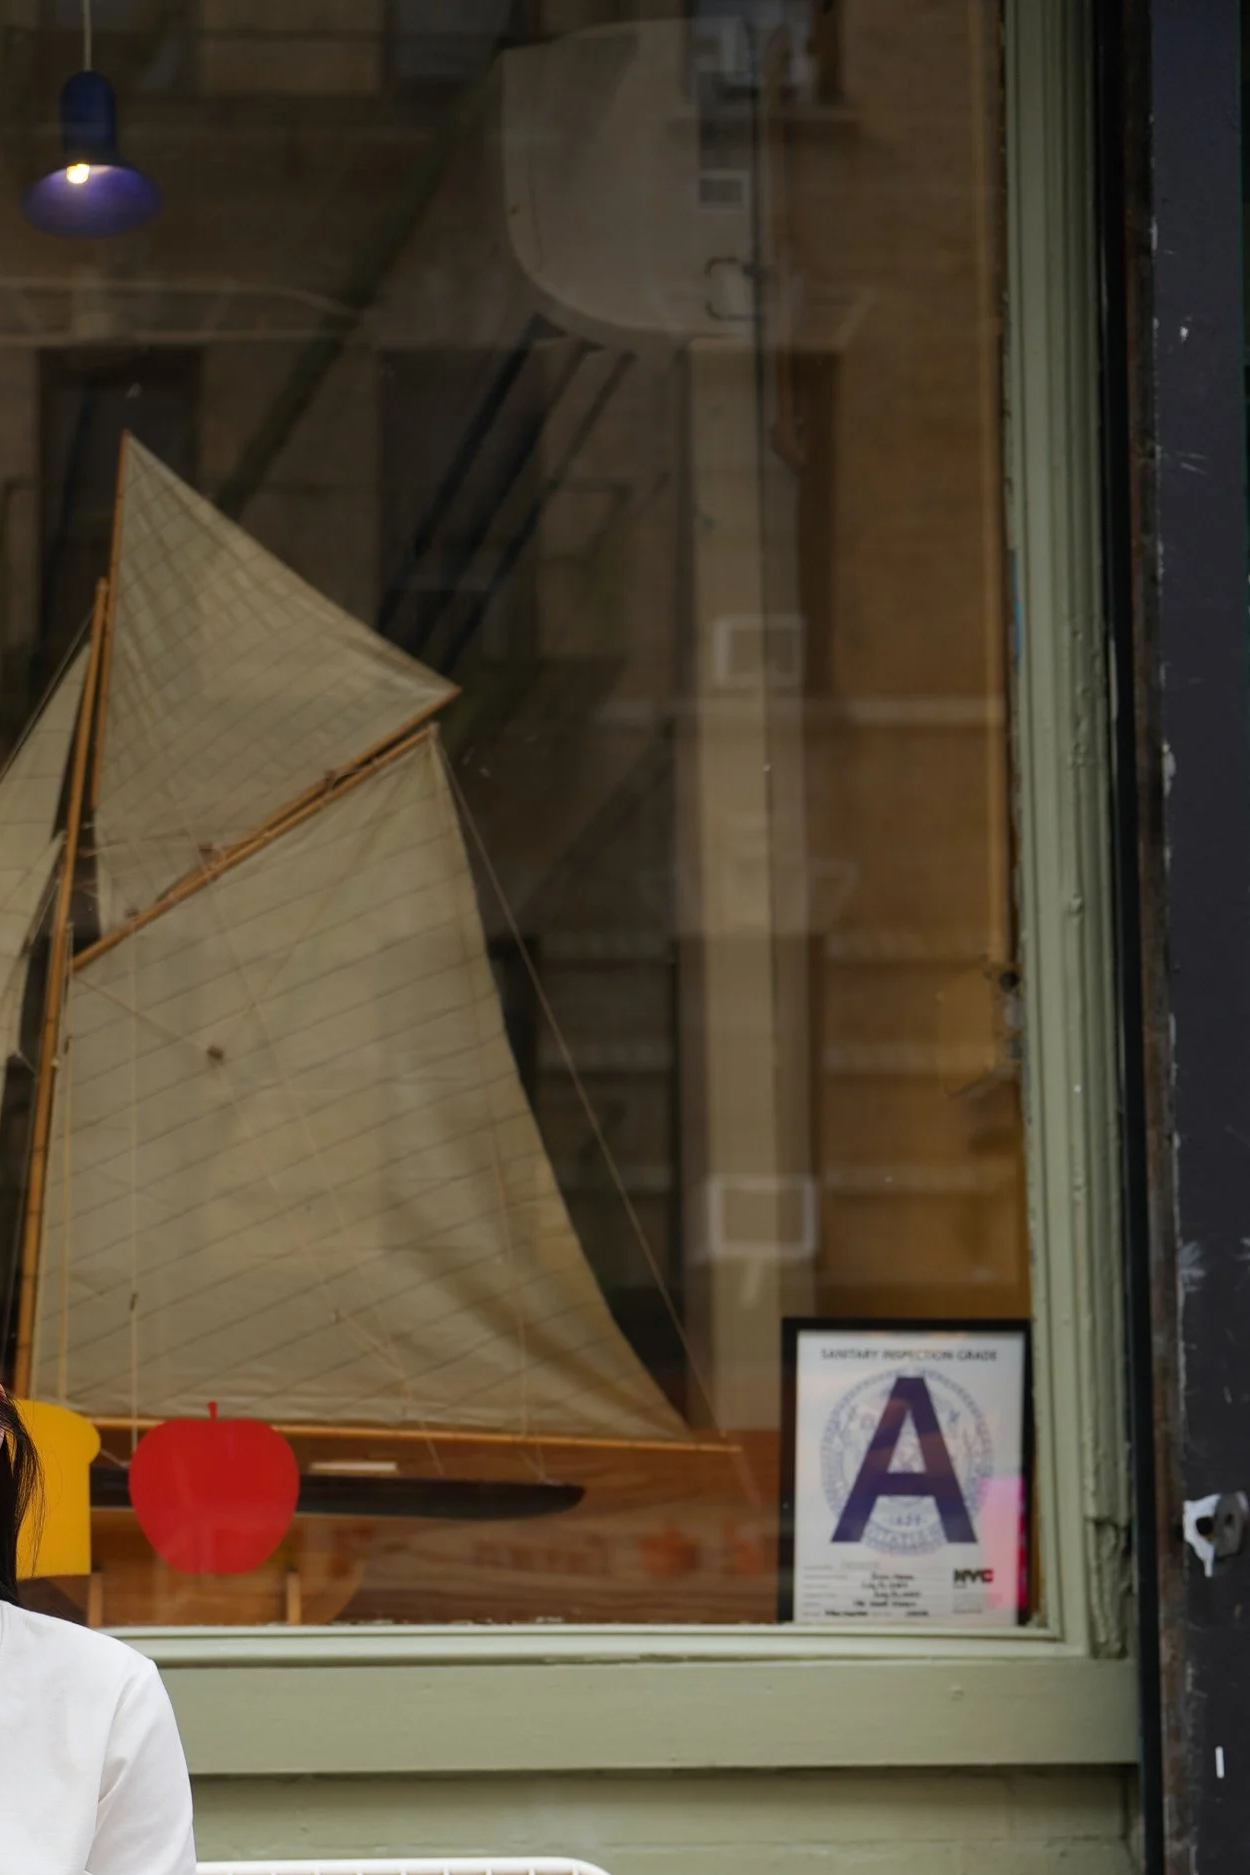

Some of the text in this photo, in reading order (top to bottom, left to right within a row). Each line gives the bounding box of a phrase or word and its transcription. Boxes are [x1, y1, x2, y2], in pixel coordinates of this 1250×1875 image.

[821, 1348, 998, 1362] SANITARY INSPECTION GRADE
[831, 1376, 977, 1543] A
[953, 1568, 993, 1584] NYC
